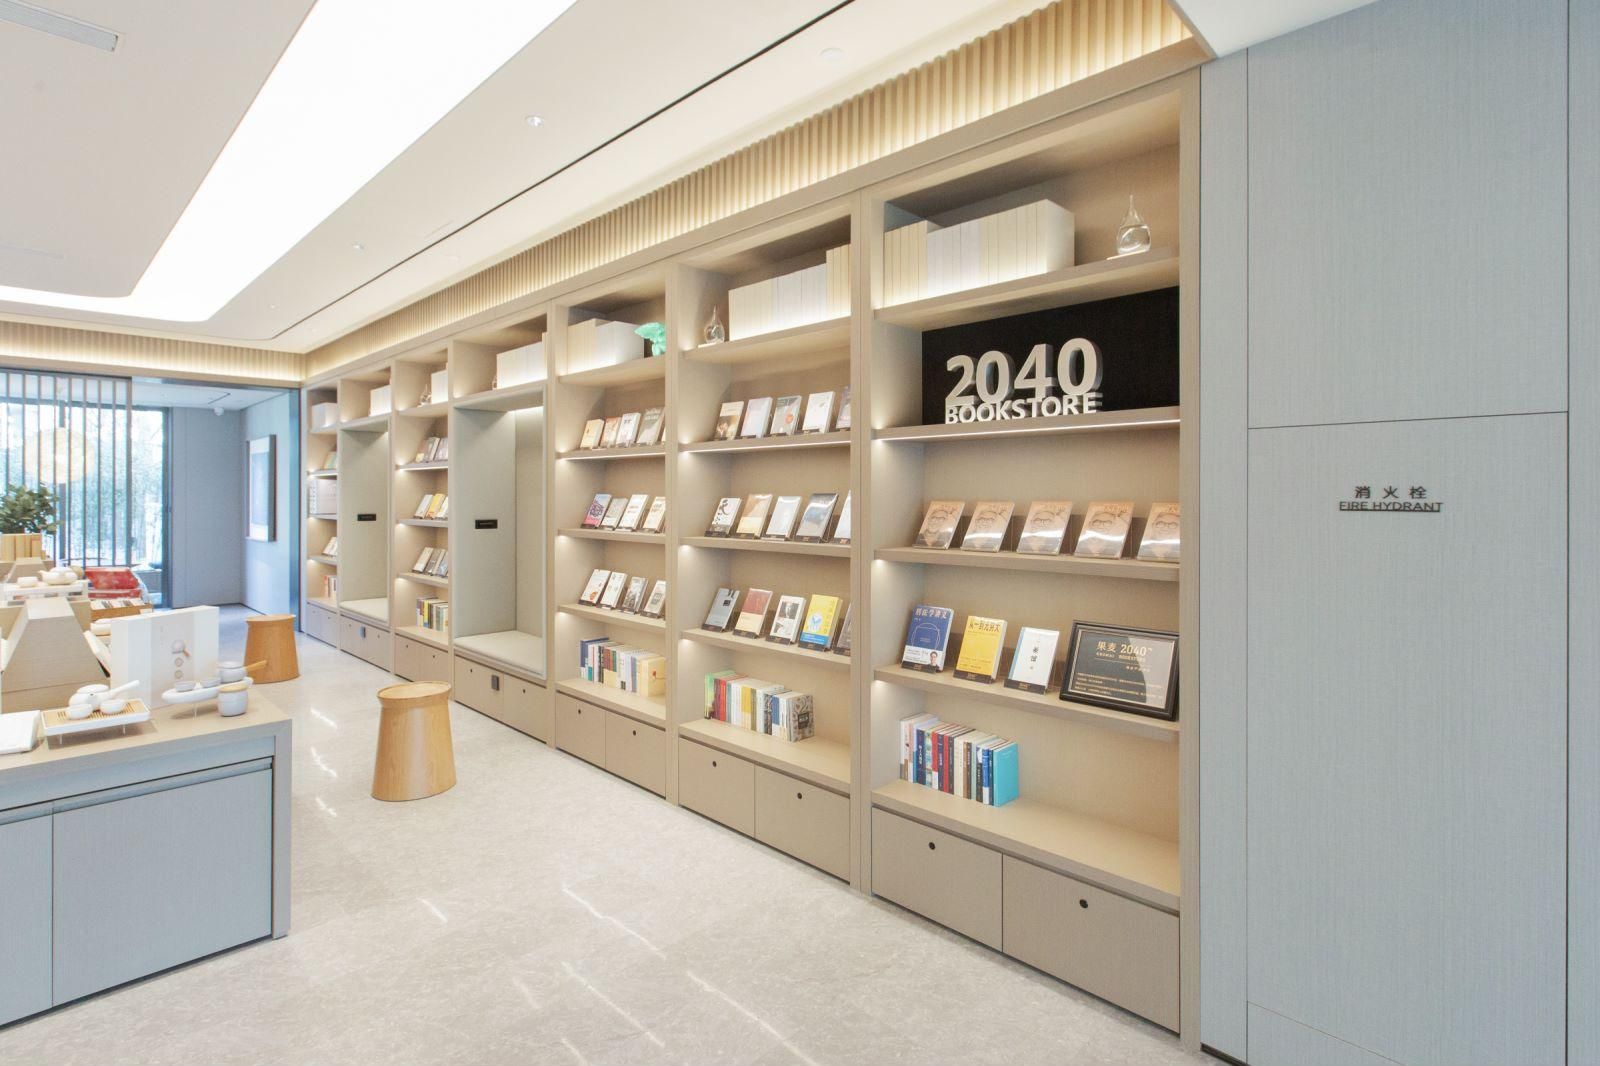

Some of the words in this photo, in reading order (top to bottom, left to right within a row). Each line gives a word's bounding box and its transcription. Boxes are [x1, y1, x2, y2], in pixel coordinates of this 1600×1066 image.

[945, 337, 1102, 405] 2040
[945, 393, 1100, 424] BOOKSTORE
[1354, 485, 1427, 499] 消火栓
[1339, 501, 1368, 511] FIRE
[1372, 501, 1443, 512] HYDRANT
